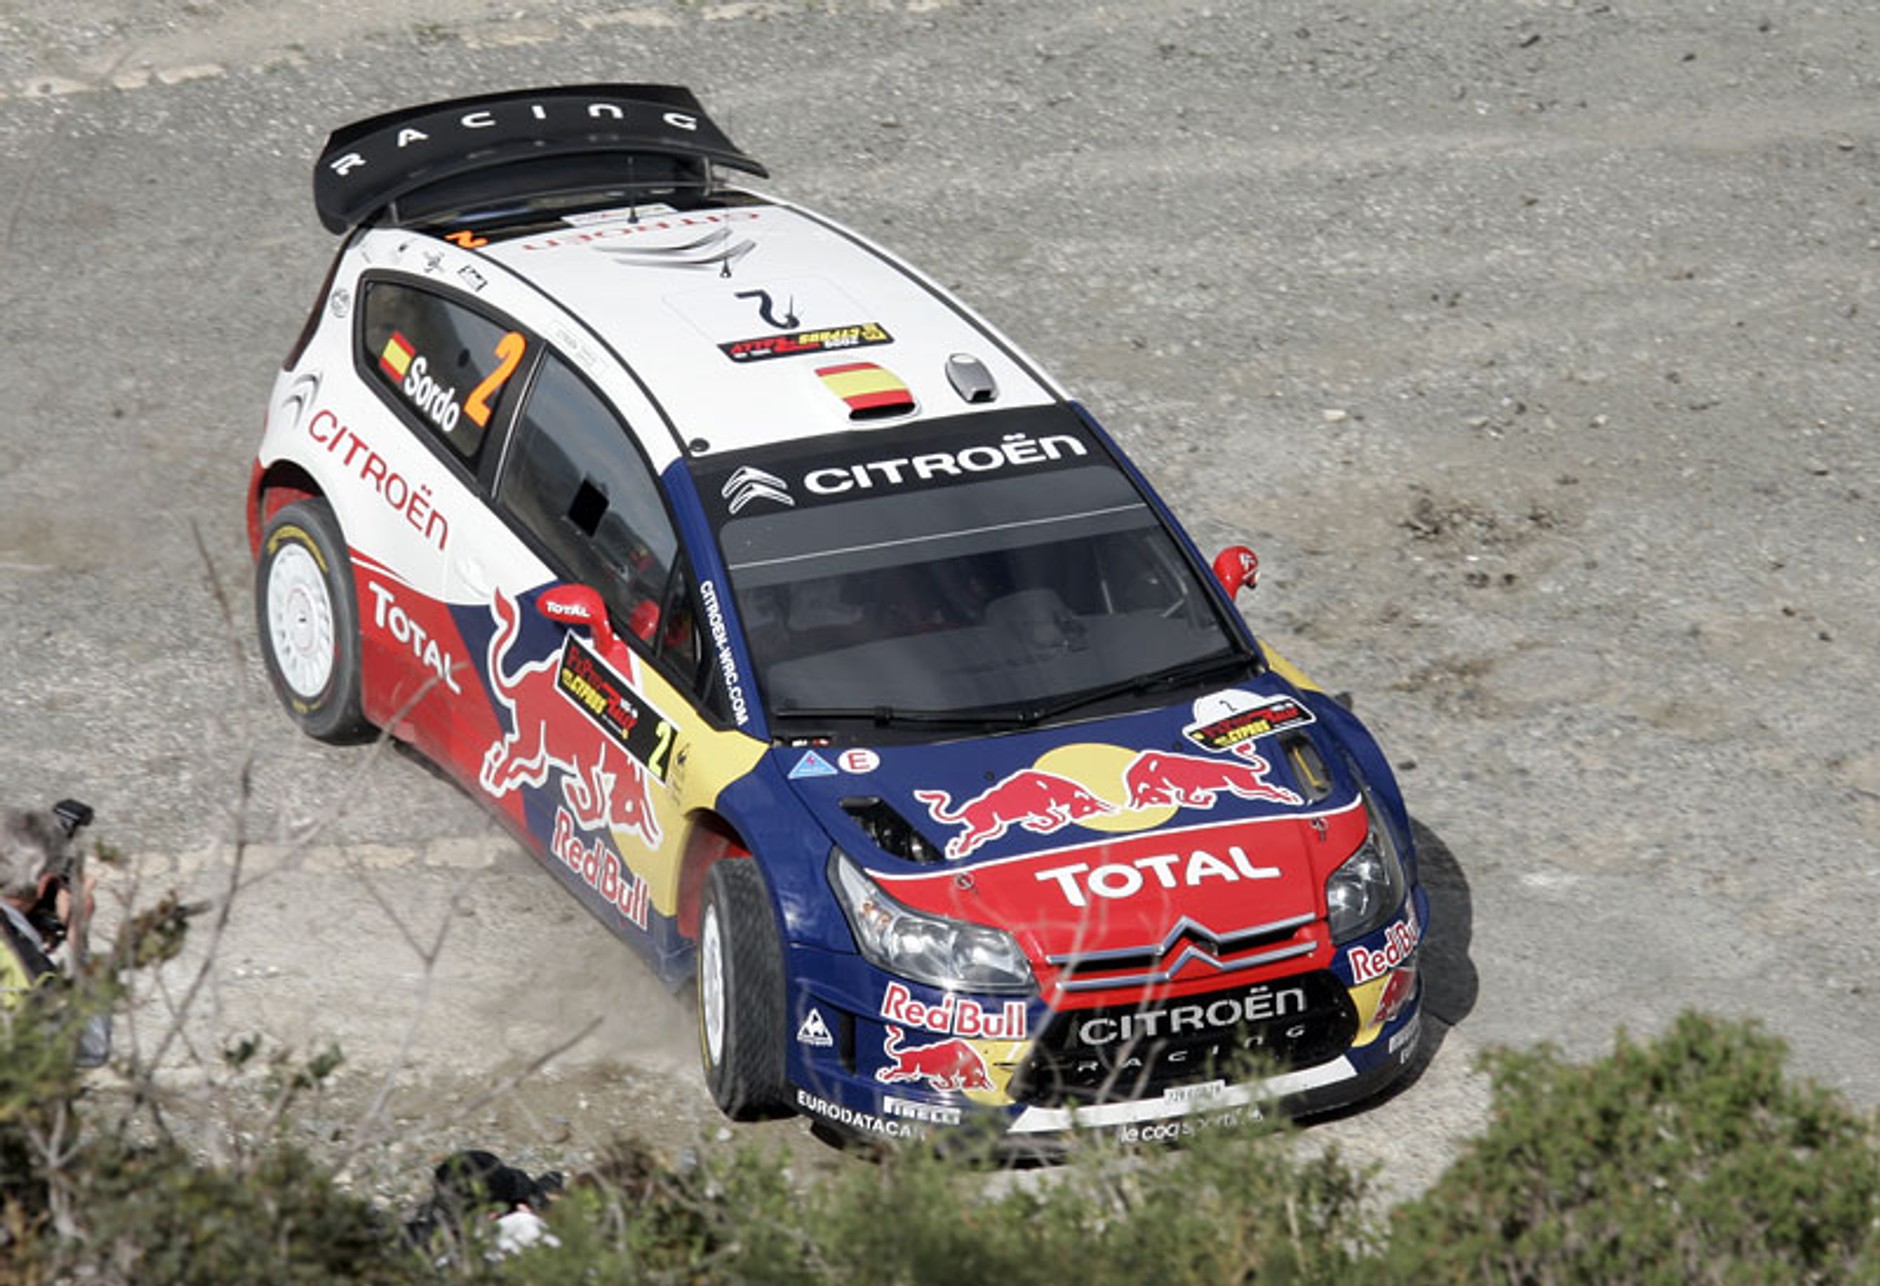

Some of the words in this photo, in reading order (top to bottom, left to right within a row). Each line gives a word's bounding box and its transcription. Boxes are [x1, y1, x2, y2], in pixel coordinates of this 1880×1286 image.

[734, 289, 800, 330] 2
[404, 356, 460, 431] Sordo
[463, 331, 526, 427] 2
[368, 581, 462, 695] TOTAL
[545, 600, 591, 618] TOTAL
[648, 721, 672, 778] 2
[847, 752, 870, 770] E
[551, 805, 604, 890] Red
[600, 848, 650, 931] Bull
[1034, 846, 1282, 907] TOTAL
[1347, 925, 1401, 984] Red
[880, 981, 955, 1034] Red
[953, 999, 1027, 1039] Bull
[884, 1095, 962, 1125] PIRELLI
